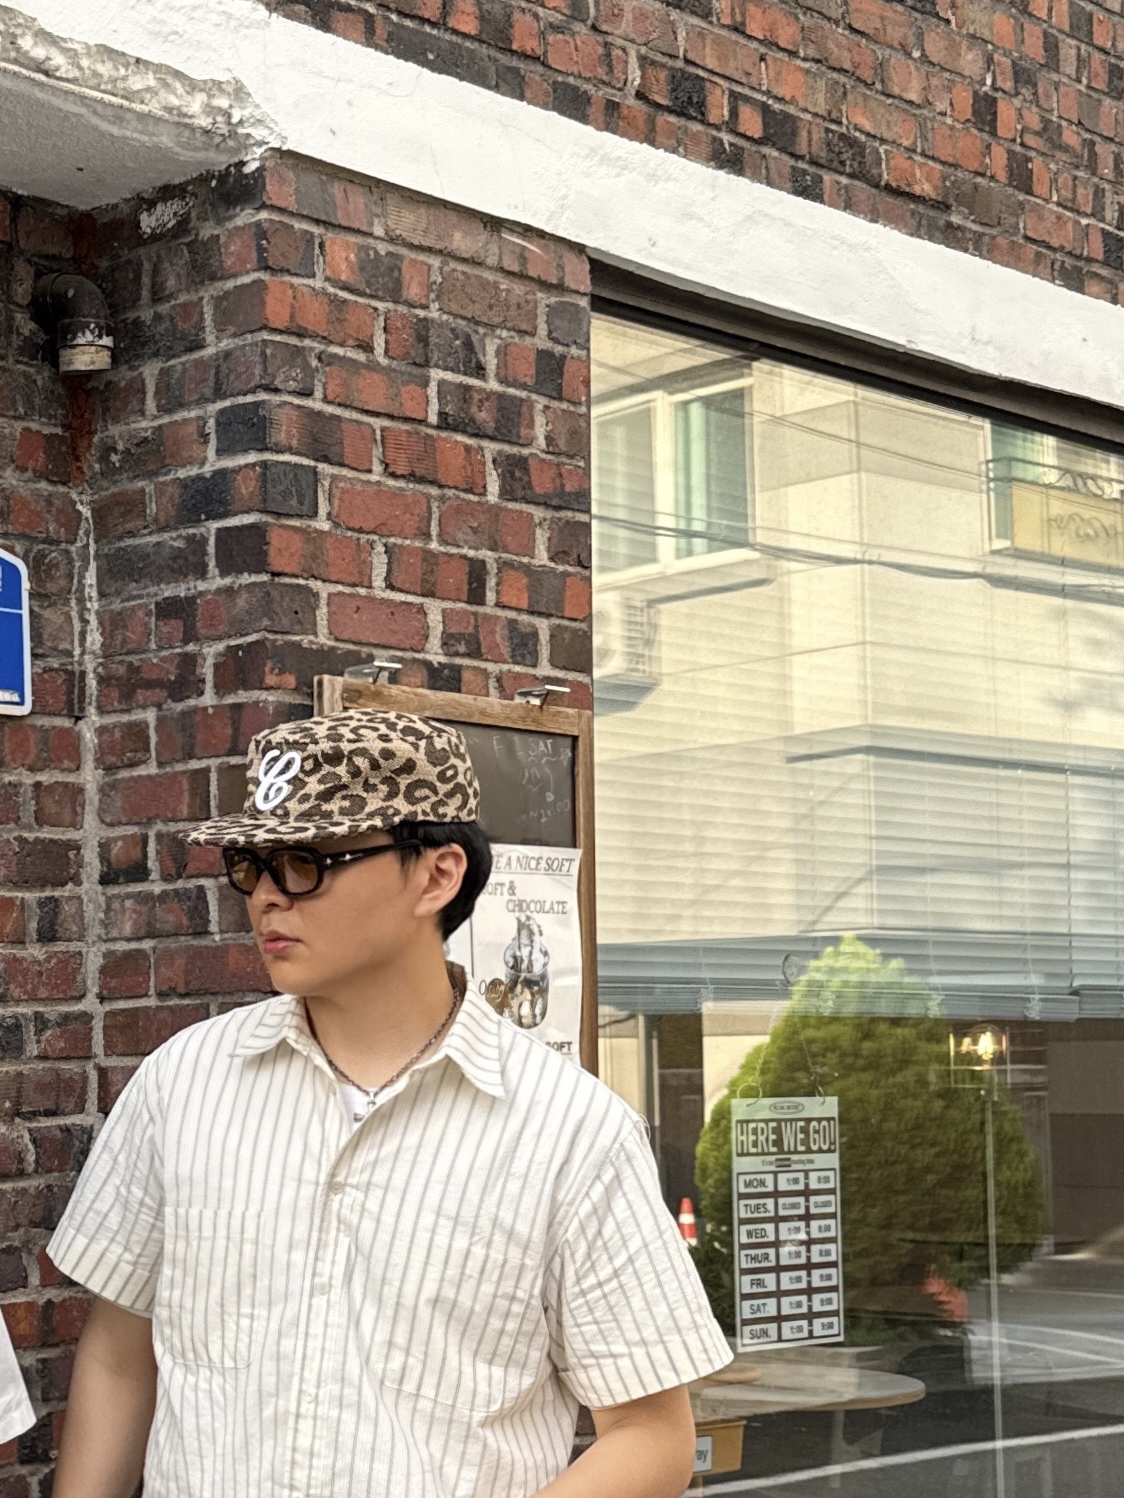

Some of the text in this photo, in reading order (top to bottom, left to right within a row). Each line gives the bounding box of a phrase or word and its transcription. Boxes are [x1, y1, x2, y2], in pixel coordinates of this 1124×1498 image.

[504, 855, 513, 871] A
[515, 855, 544, 872] NICE
[544, 857, 576, 873] SOFT
[507, 880, 517, 896] &
[506, 898, 569, 915] CHOCOLATE
[736, 1119, 836, 1154] HERE WE GO!
[743, 1177, 768, 1189] MON.
[743, 1202, 771, 1215] TUES.
[745, 1227, 769, 1240] WED.
[744, 1252, 772, 1265] THUR.
[749, 1302, 770, 1315] SAT.
[749, 1327, 771, 1340] SUN.
